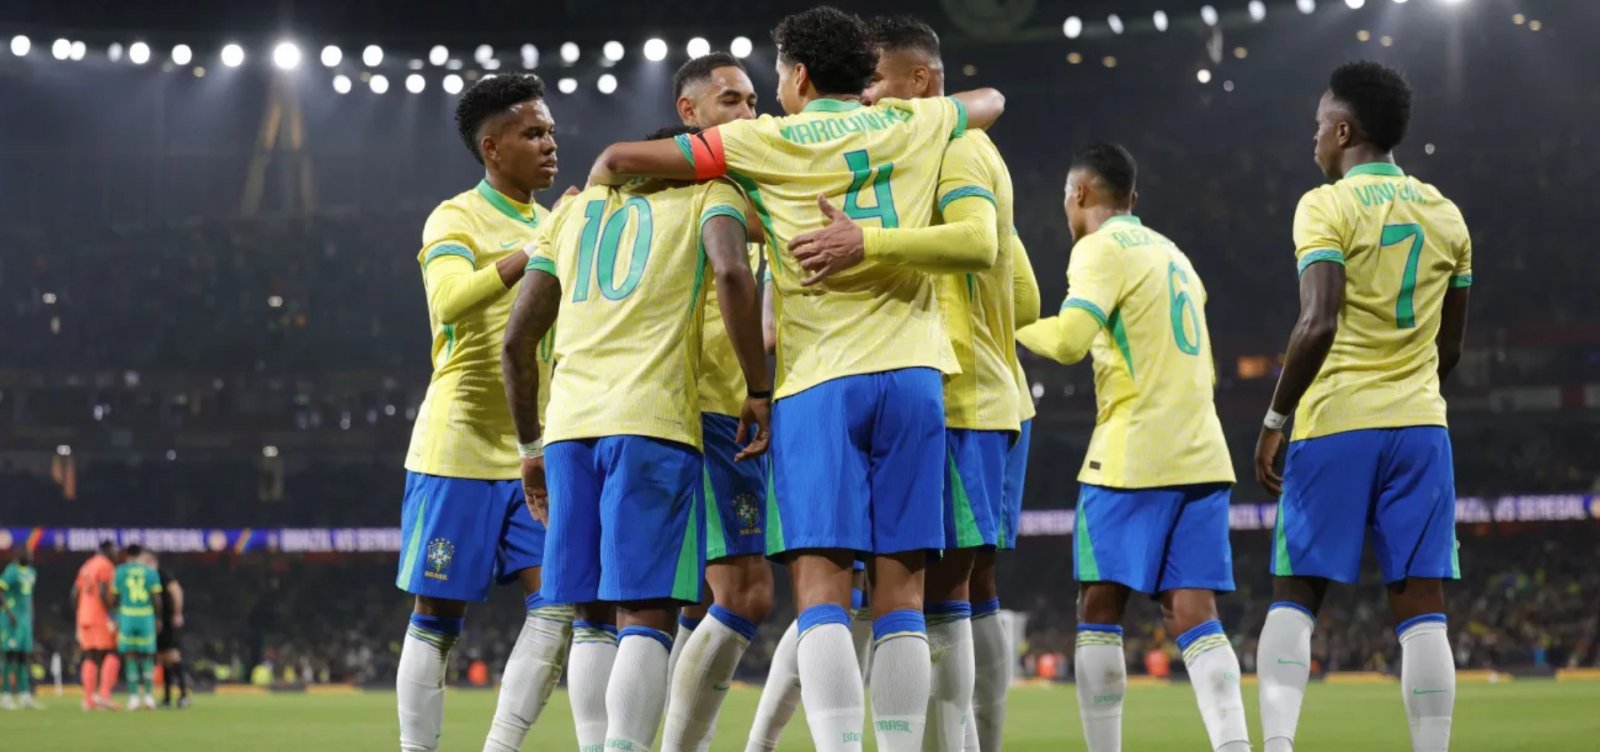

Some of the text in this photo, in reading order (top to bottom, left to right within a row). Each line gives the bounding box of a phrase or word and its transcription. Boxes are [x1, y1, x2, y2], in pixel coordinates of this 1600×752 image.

[780, 105, 913, 144] MARQUINH
[843, 149, 899, 229] 4
[573, 196, 653, 303] 10
[1380, 223, 1424, 329] 7
[1168, 261, 1200, 356] 6
